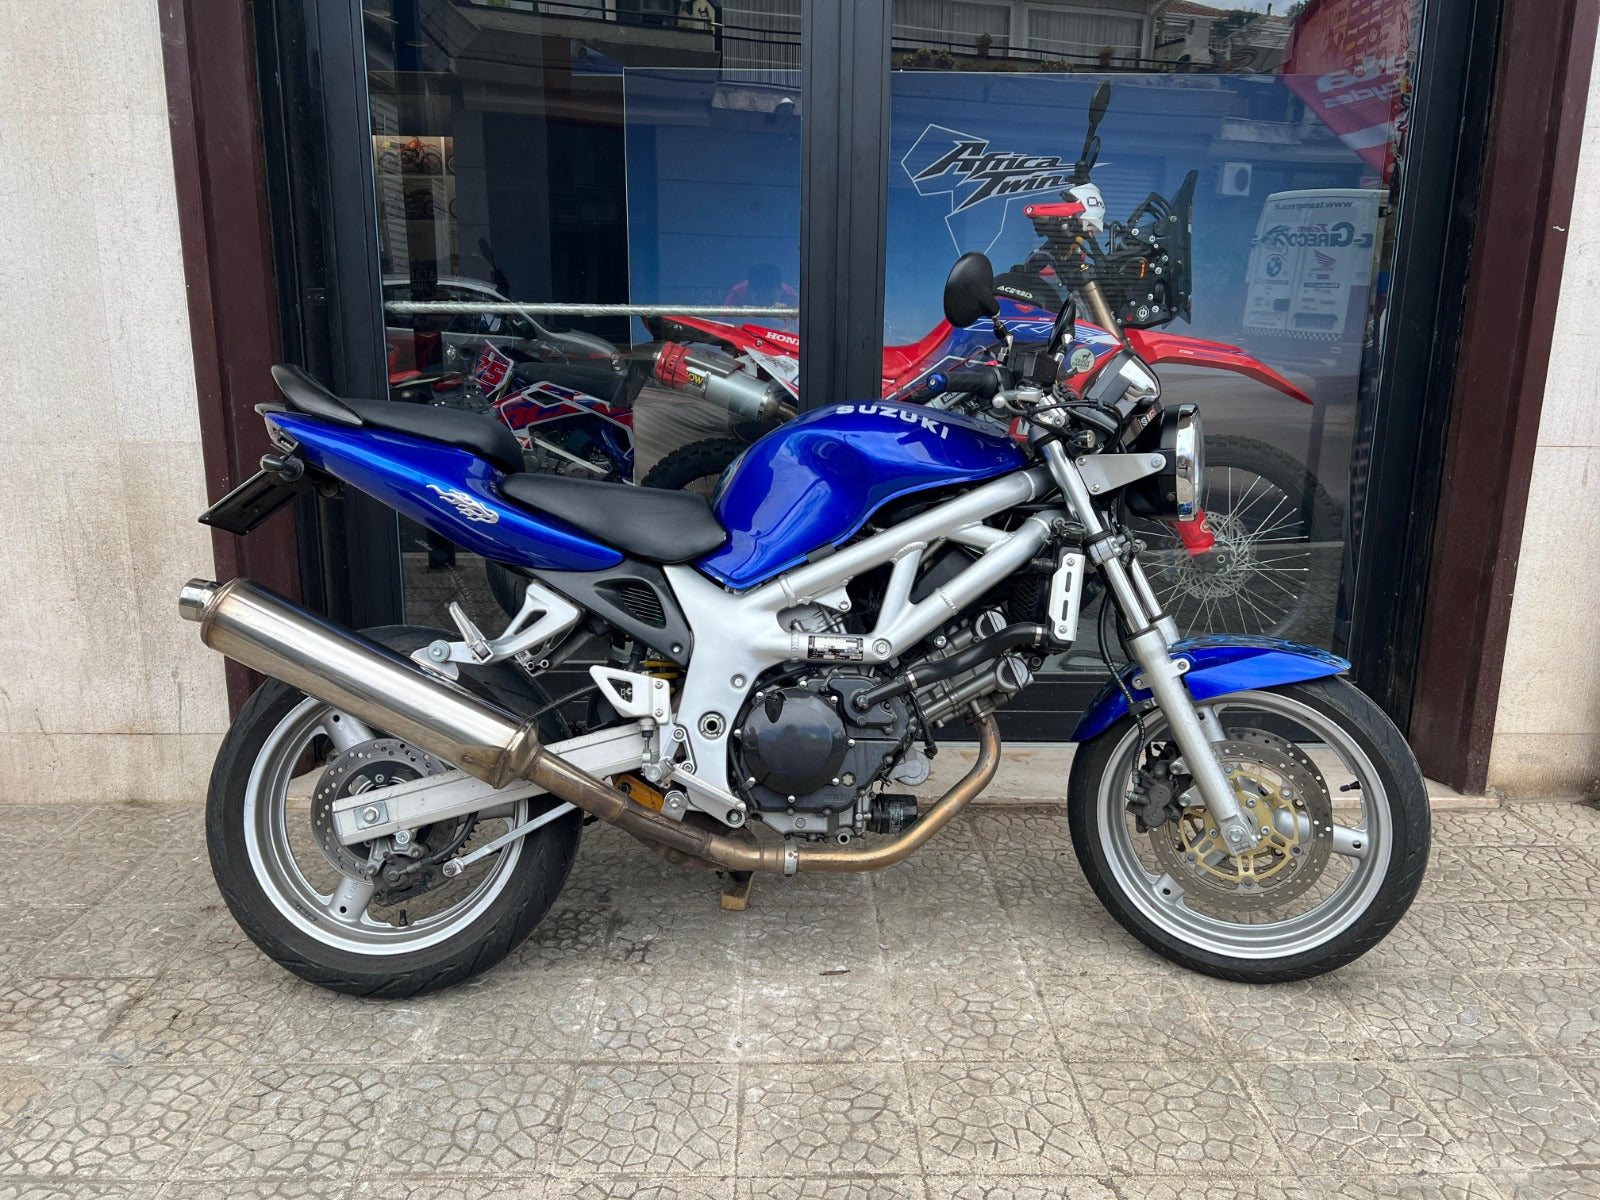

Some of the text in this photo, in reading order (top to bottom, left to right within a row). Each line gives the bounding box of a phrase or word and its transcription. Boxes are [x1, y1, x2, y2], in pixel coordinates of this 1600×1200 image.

[912, 140, 1064, 182] Africa
[952, 169, 1067, 214] Twin
[996, 285, 1034, 300] ACERBIS
[687, 372, 705, 386] OW
[835, 404, 949, 440] SUZUKI
